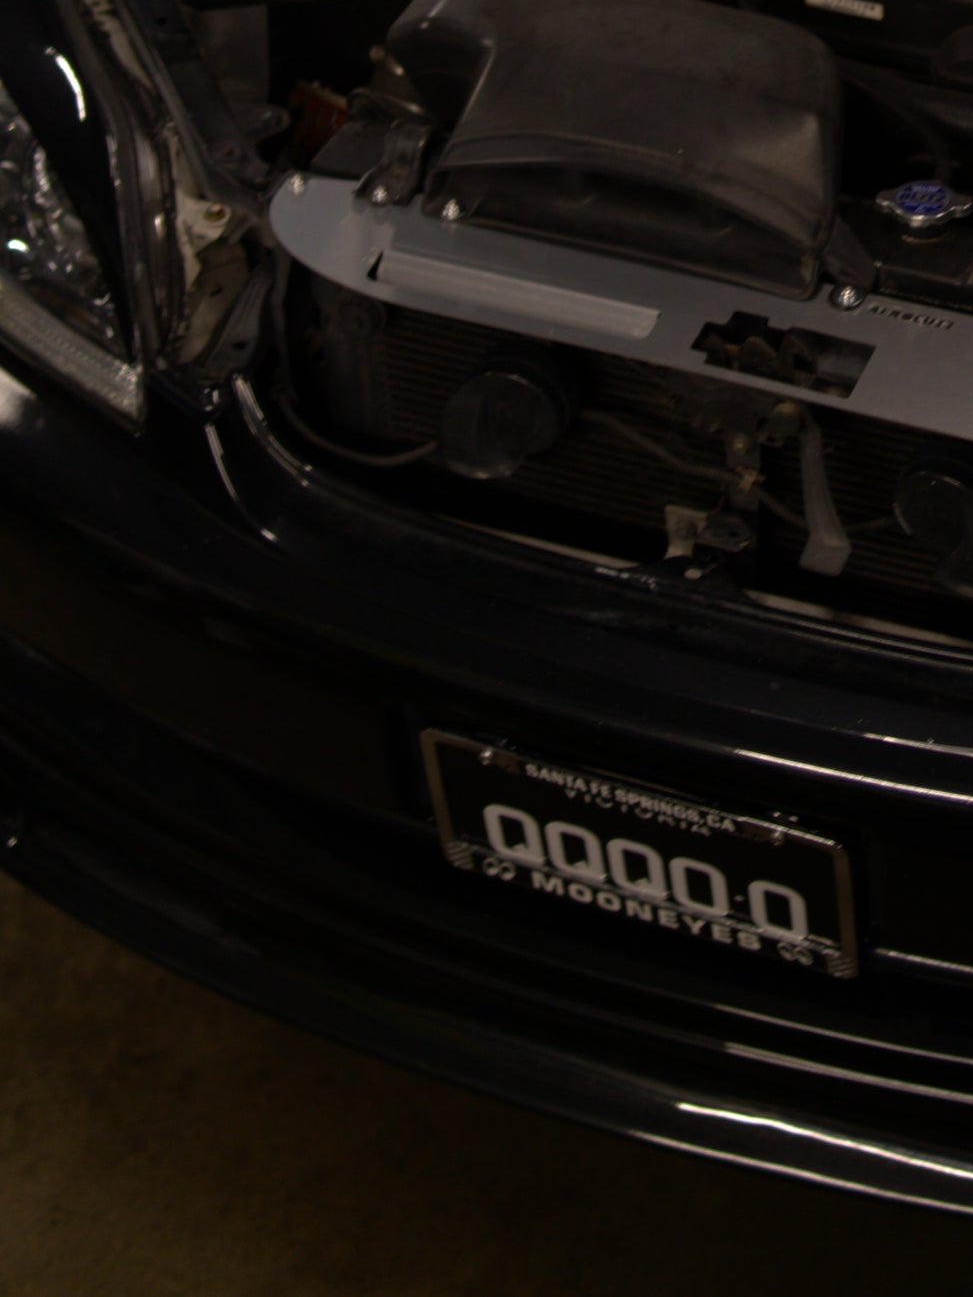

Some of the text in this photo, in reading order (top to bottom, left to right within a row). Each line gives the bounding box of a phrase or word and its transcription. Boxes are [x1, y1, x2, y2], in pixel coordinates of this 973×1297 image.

[525, 763, 588, 792] SANTA
[590, 781, 613, 799] FE
[531, 871, 763, 952] MOONEYES
